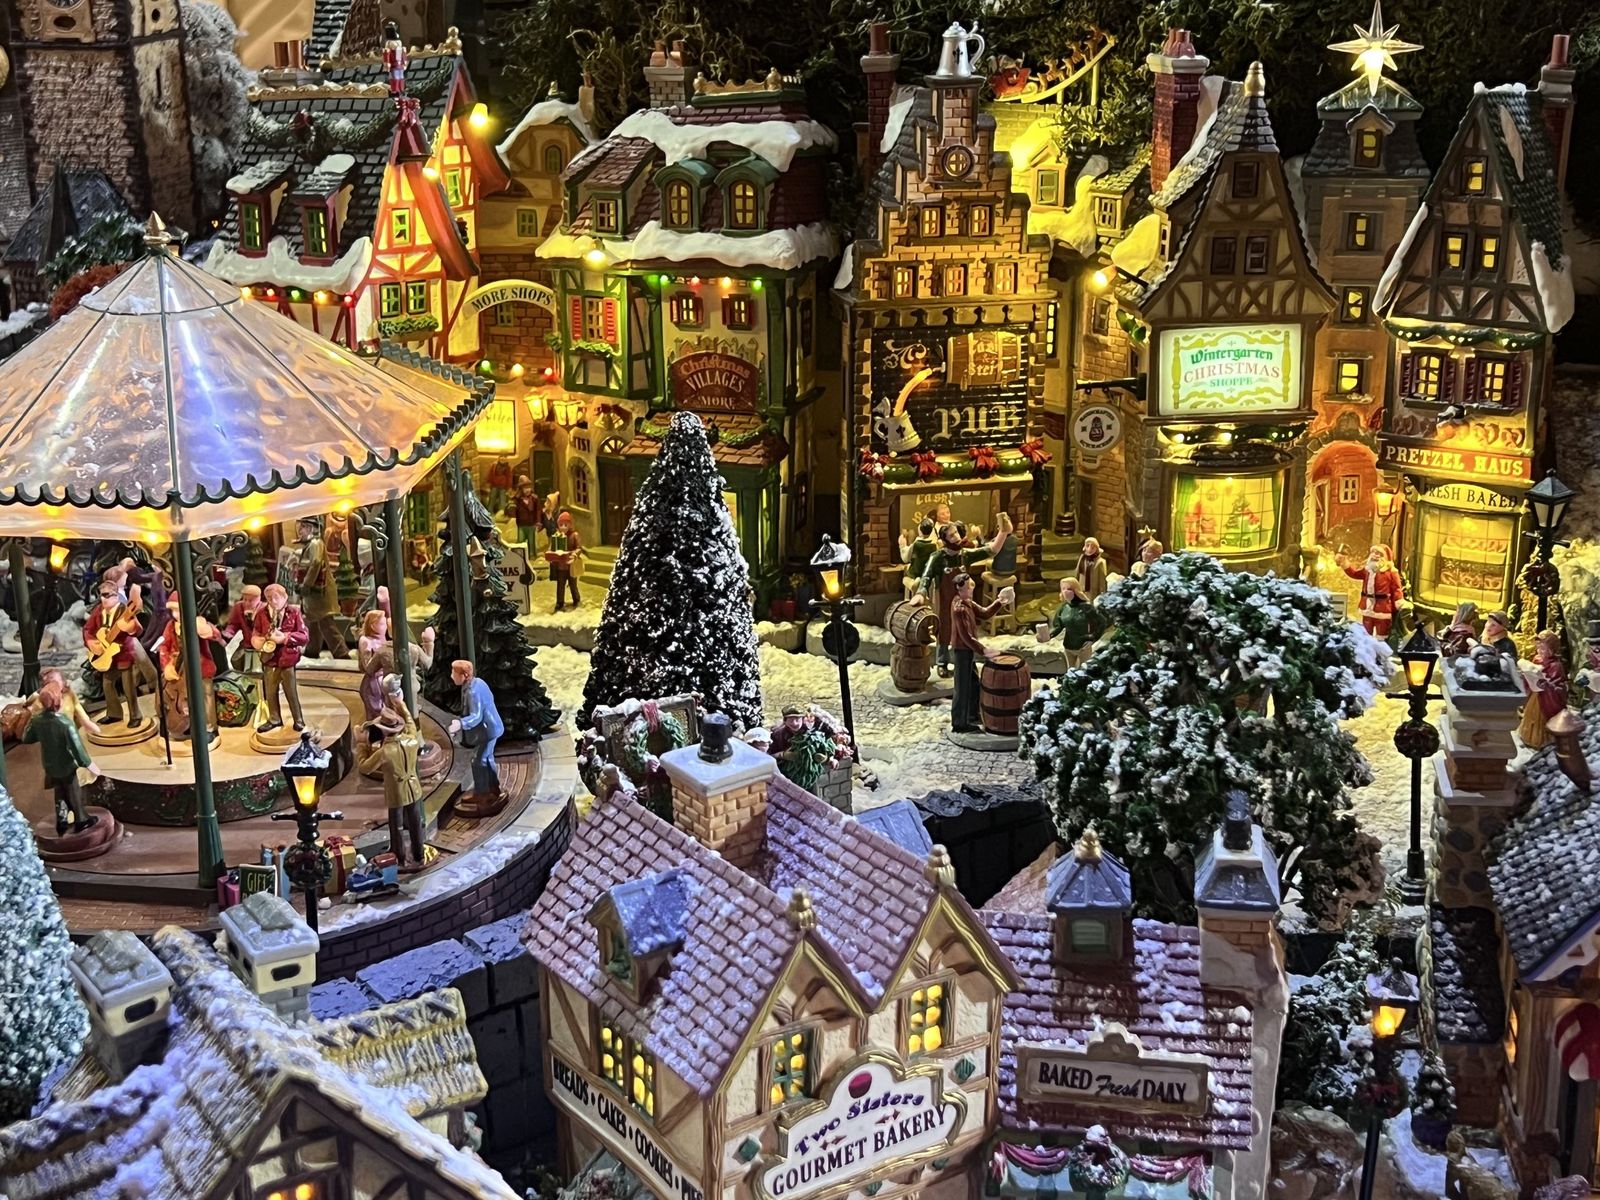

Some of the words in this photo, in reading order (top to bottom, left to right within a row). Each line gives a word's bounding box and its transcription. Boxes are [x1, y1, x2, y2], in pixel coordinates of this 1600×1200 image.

[471, 288, 508, 312] MORE
[511, 287, 554, 306] SHOPS
[680, 354, 751, 378] Christmas
[1190, 348, 1273, 364] Wintergarten
[686, 370, 745, 393] VILLAGES
[1183, 361, 1280, 383] CHRISTMAS
[1210, 377, 1253, 388] SHOPPE
[698, 395, 736, 410] MORE
[1385, 445, 1465, 472] PRETZEL
[1473, 455, 1524, 476] HAUS
[1466, 489, 1518, 509] BAKED
[247, 872, 267, 892] GIFT
[1038, 1061, 1093, 1090] BAKED
[1094, 1074, 1141, 1098] Fresh
[1142, 1079, 1187, 1104] DAILY
[553, 1056, 589, 1106] BREADS
[597, 1093, 627, 1139] CAKES
[635, 1127, 673, 1189] COOKIES
[794, 1117, 841, 1156] Two
[846, 1090, 925, 1121] Sisters
[771, 1137, 868, 1197] GOURMET
[872, 1102, 948, 1153] BAKERY
